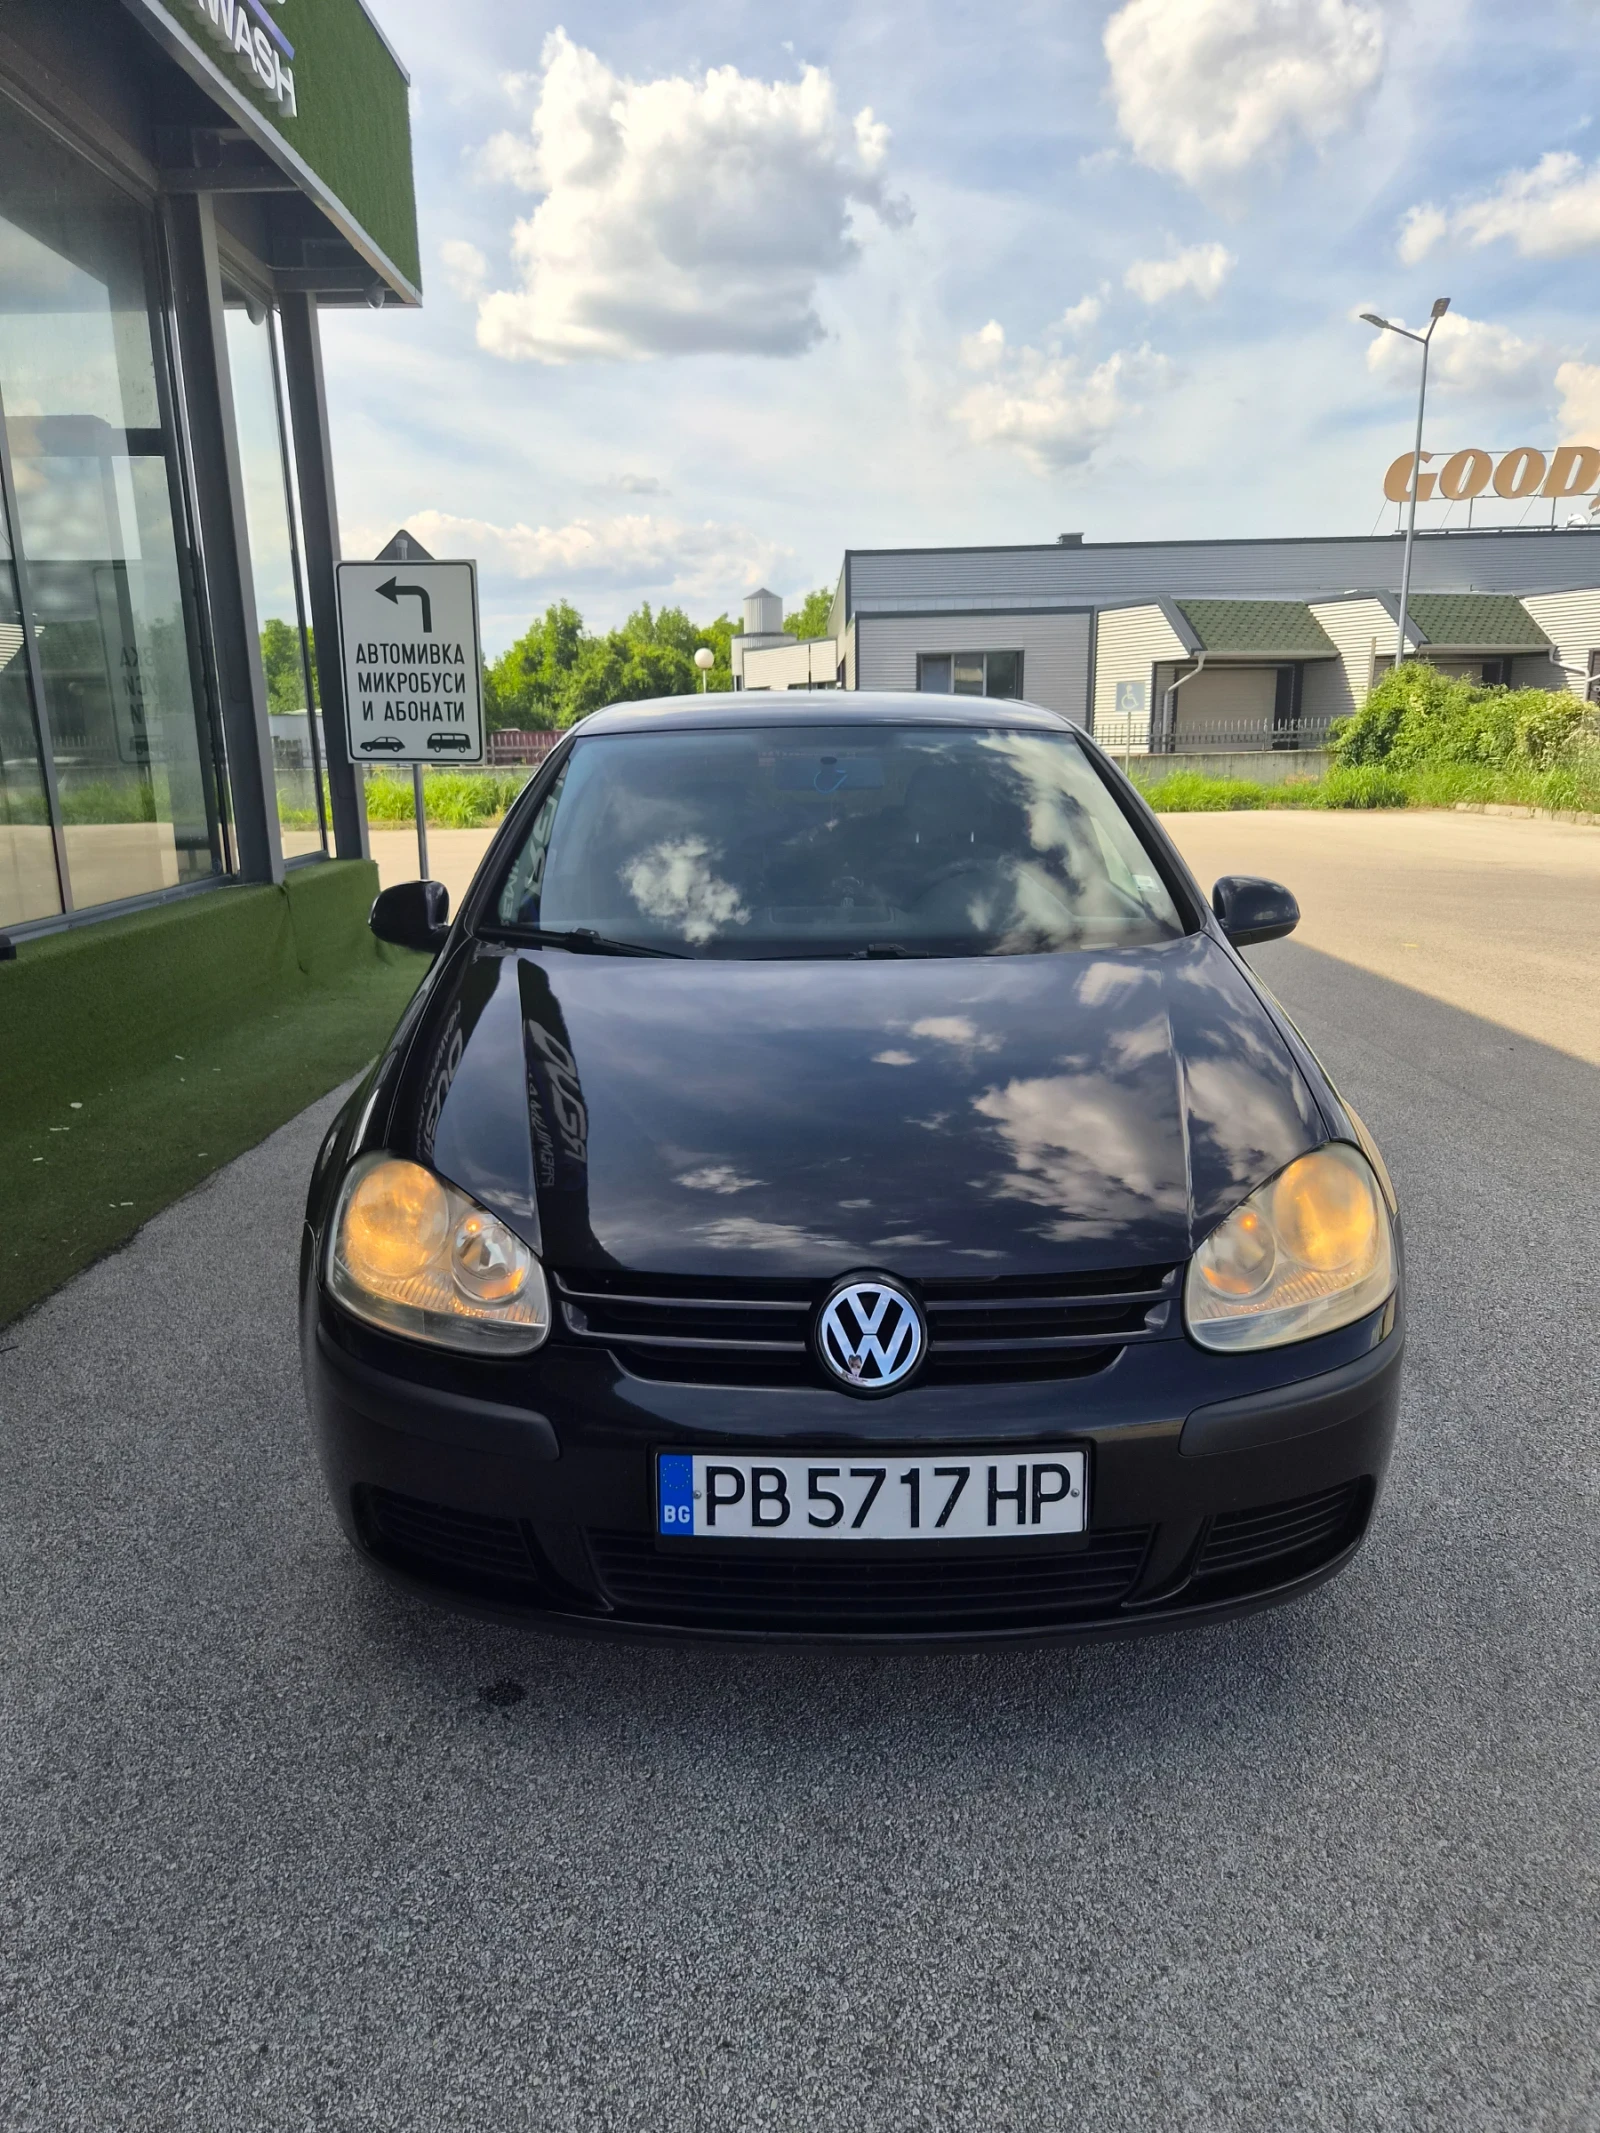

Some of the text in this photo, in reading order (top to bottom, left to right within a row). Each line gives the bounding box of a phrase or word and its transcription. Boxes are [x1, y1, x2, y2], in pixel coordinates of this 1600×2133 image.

[198, 0, 298, 117] WASH
[1383, 447, 1600, 502] GOOD
[356, 643, 465, 664] АВТОМИВКА
[358, 672, 465, 693] МИКРОБУСИ
[362, 701, 465, 722] И АБОНАТИ
[706, 1463, 1071, 1528] PB 5717 HP
[664, 1505, 690, 1523] BG
